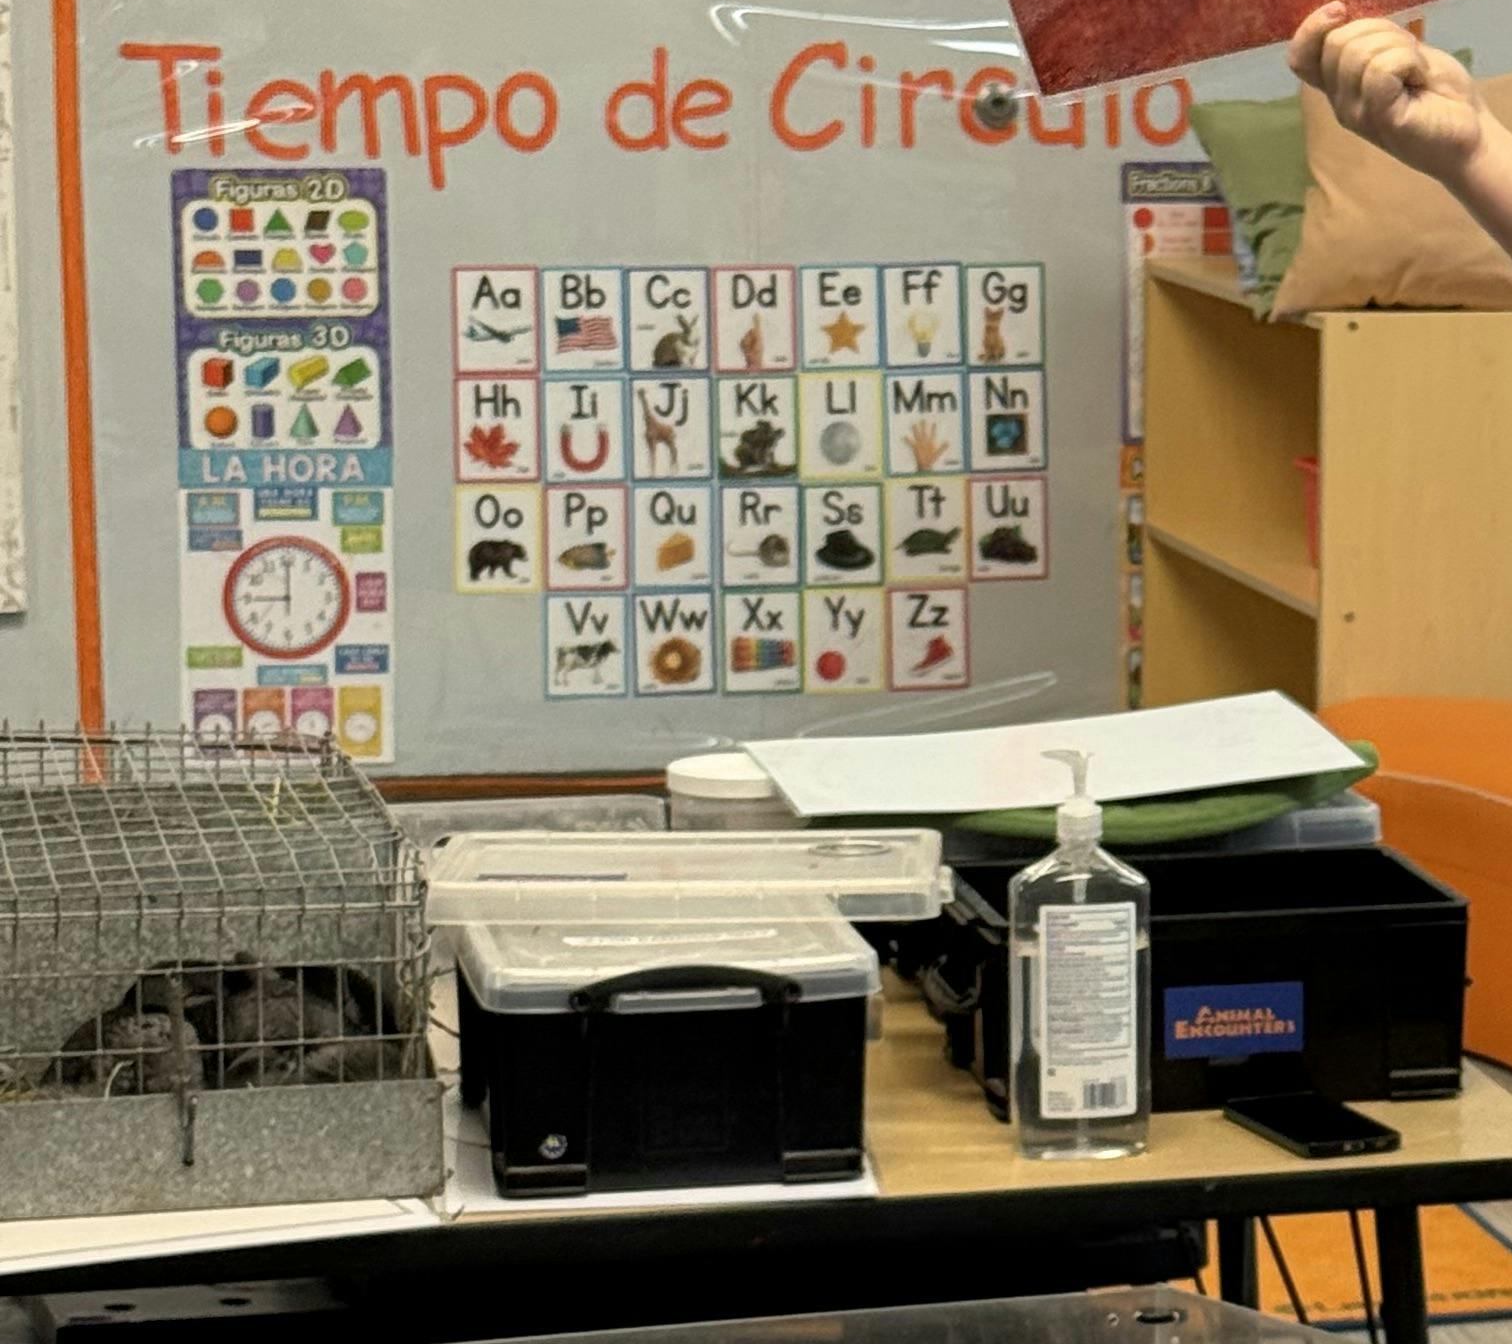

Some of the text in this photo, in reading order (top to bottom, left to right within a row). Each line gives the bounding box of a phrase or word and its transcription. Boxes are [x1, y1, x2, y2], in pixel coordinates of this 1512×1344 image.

[119, 42, 560, 192] Tiempo
[604, 46, 733, 151] de
[214, 179, 346, 202] Figuras 2D
[471, 274, 523, 311] Aa
[560, 274, 607, 311] Bb
[646, 274, 692, 310] Cc
[731, 273, 778, 309] Dd
[818, 271, 863, 307] Ee
[901, 270, 943, 305] Ff
[981, 271, 1028, 313] Gg
[219, 325, 350, 352] Figuras 3D
[474, 383, 522, 419] Hh
[570, 385, 598, 419] Ii
[654, 383, 689, 426] Jj
[735, 382, 780, 417] Kk
[825, 380, 857, 415] Ll
[893, 379, 957, 414] Mm
[984, 376, 1030, 410] Nn
[202, 453, 365, 483] LA HORA
[474, 493, 524, 529] Oo
[563, 492, 608, 535] Pp
[650, 491, 697, 526] Qu
[739, 490, 782, 526] Rr
[822, 490, 865, 526] Ss
[909, 484, 947, 519] Tt
[985, 485, 1030, 519] Uu
[565, 600, 609, 636] Vv
[640, 598, 708, 633] Ww
[742, 596, 784, 632] Xx
[824, 595, 866, 639] Yy
[907, 594, 949, 628] Zz
[1174, 1018, 1296, 1040] ENCOUNTERS
[1195, 1005, 1276, 1025] ANIMAL
